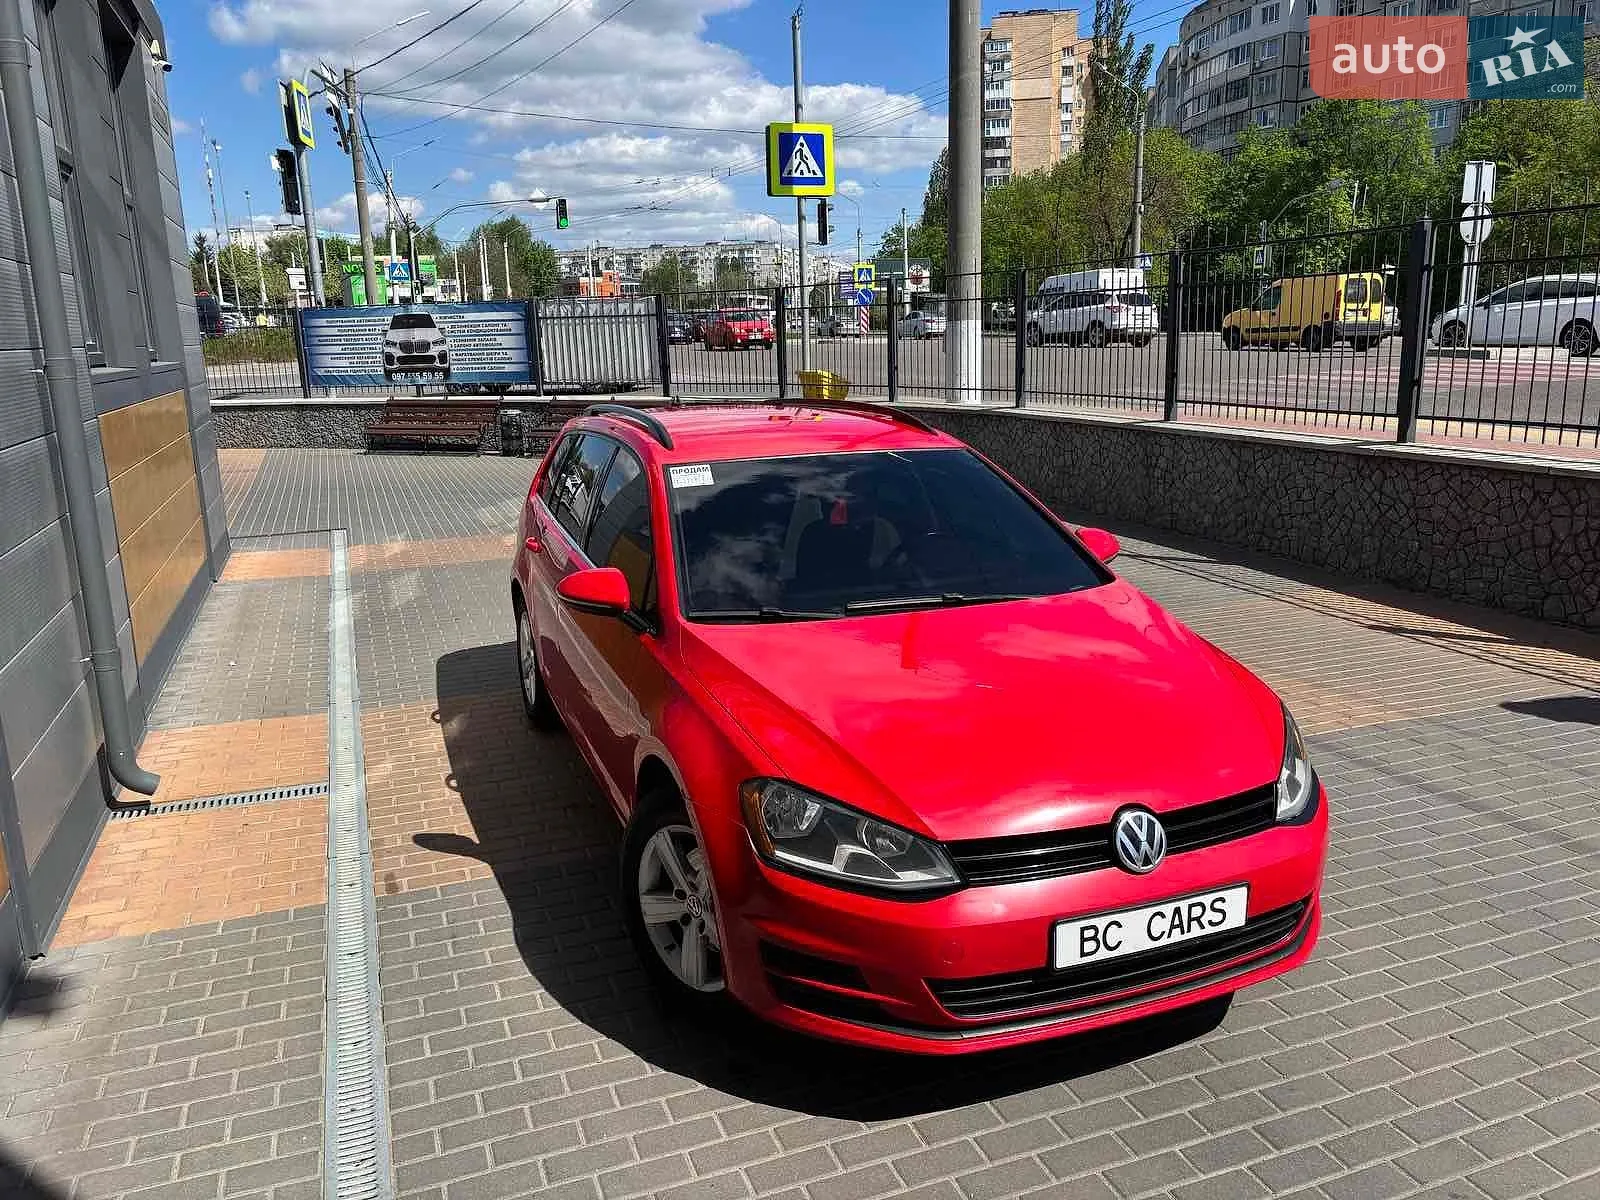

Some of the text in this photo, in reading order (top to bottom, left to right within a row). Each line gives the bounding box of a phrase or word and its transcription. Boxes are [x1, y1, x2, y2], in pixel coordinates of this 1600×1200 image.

[342, 264, 381, 273] NOVS
[671, 467, 710, 475] ПРОДАМ
[1079, 897, 1227, 958] BC CARS
